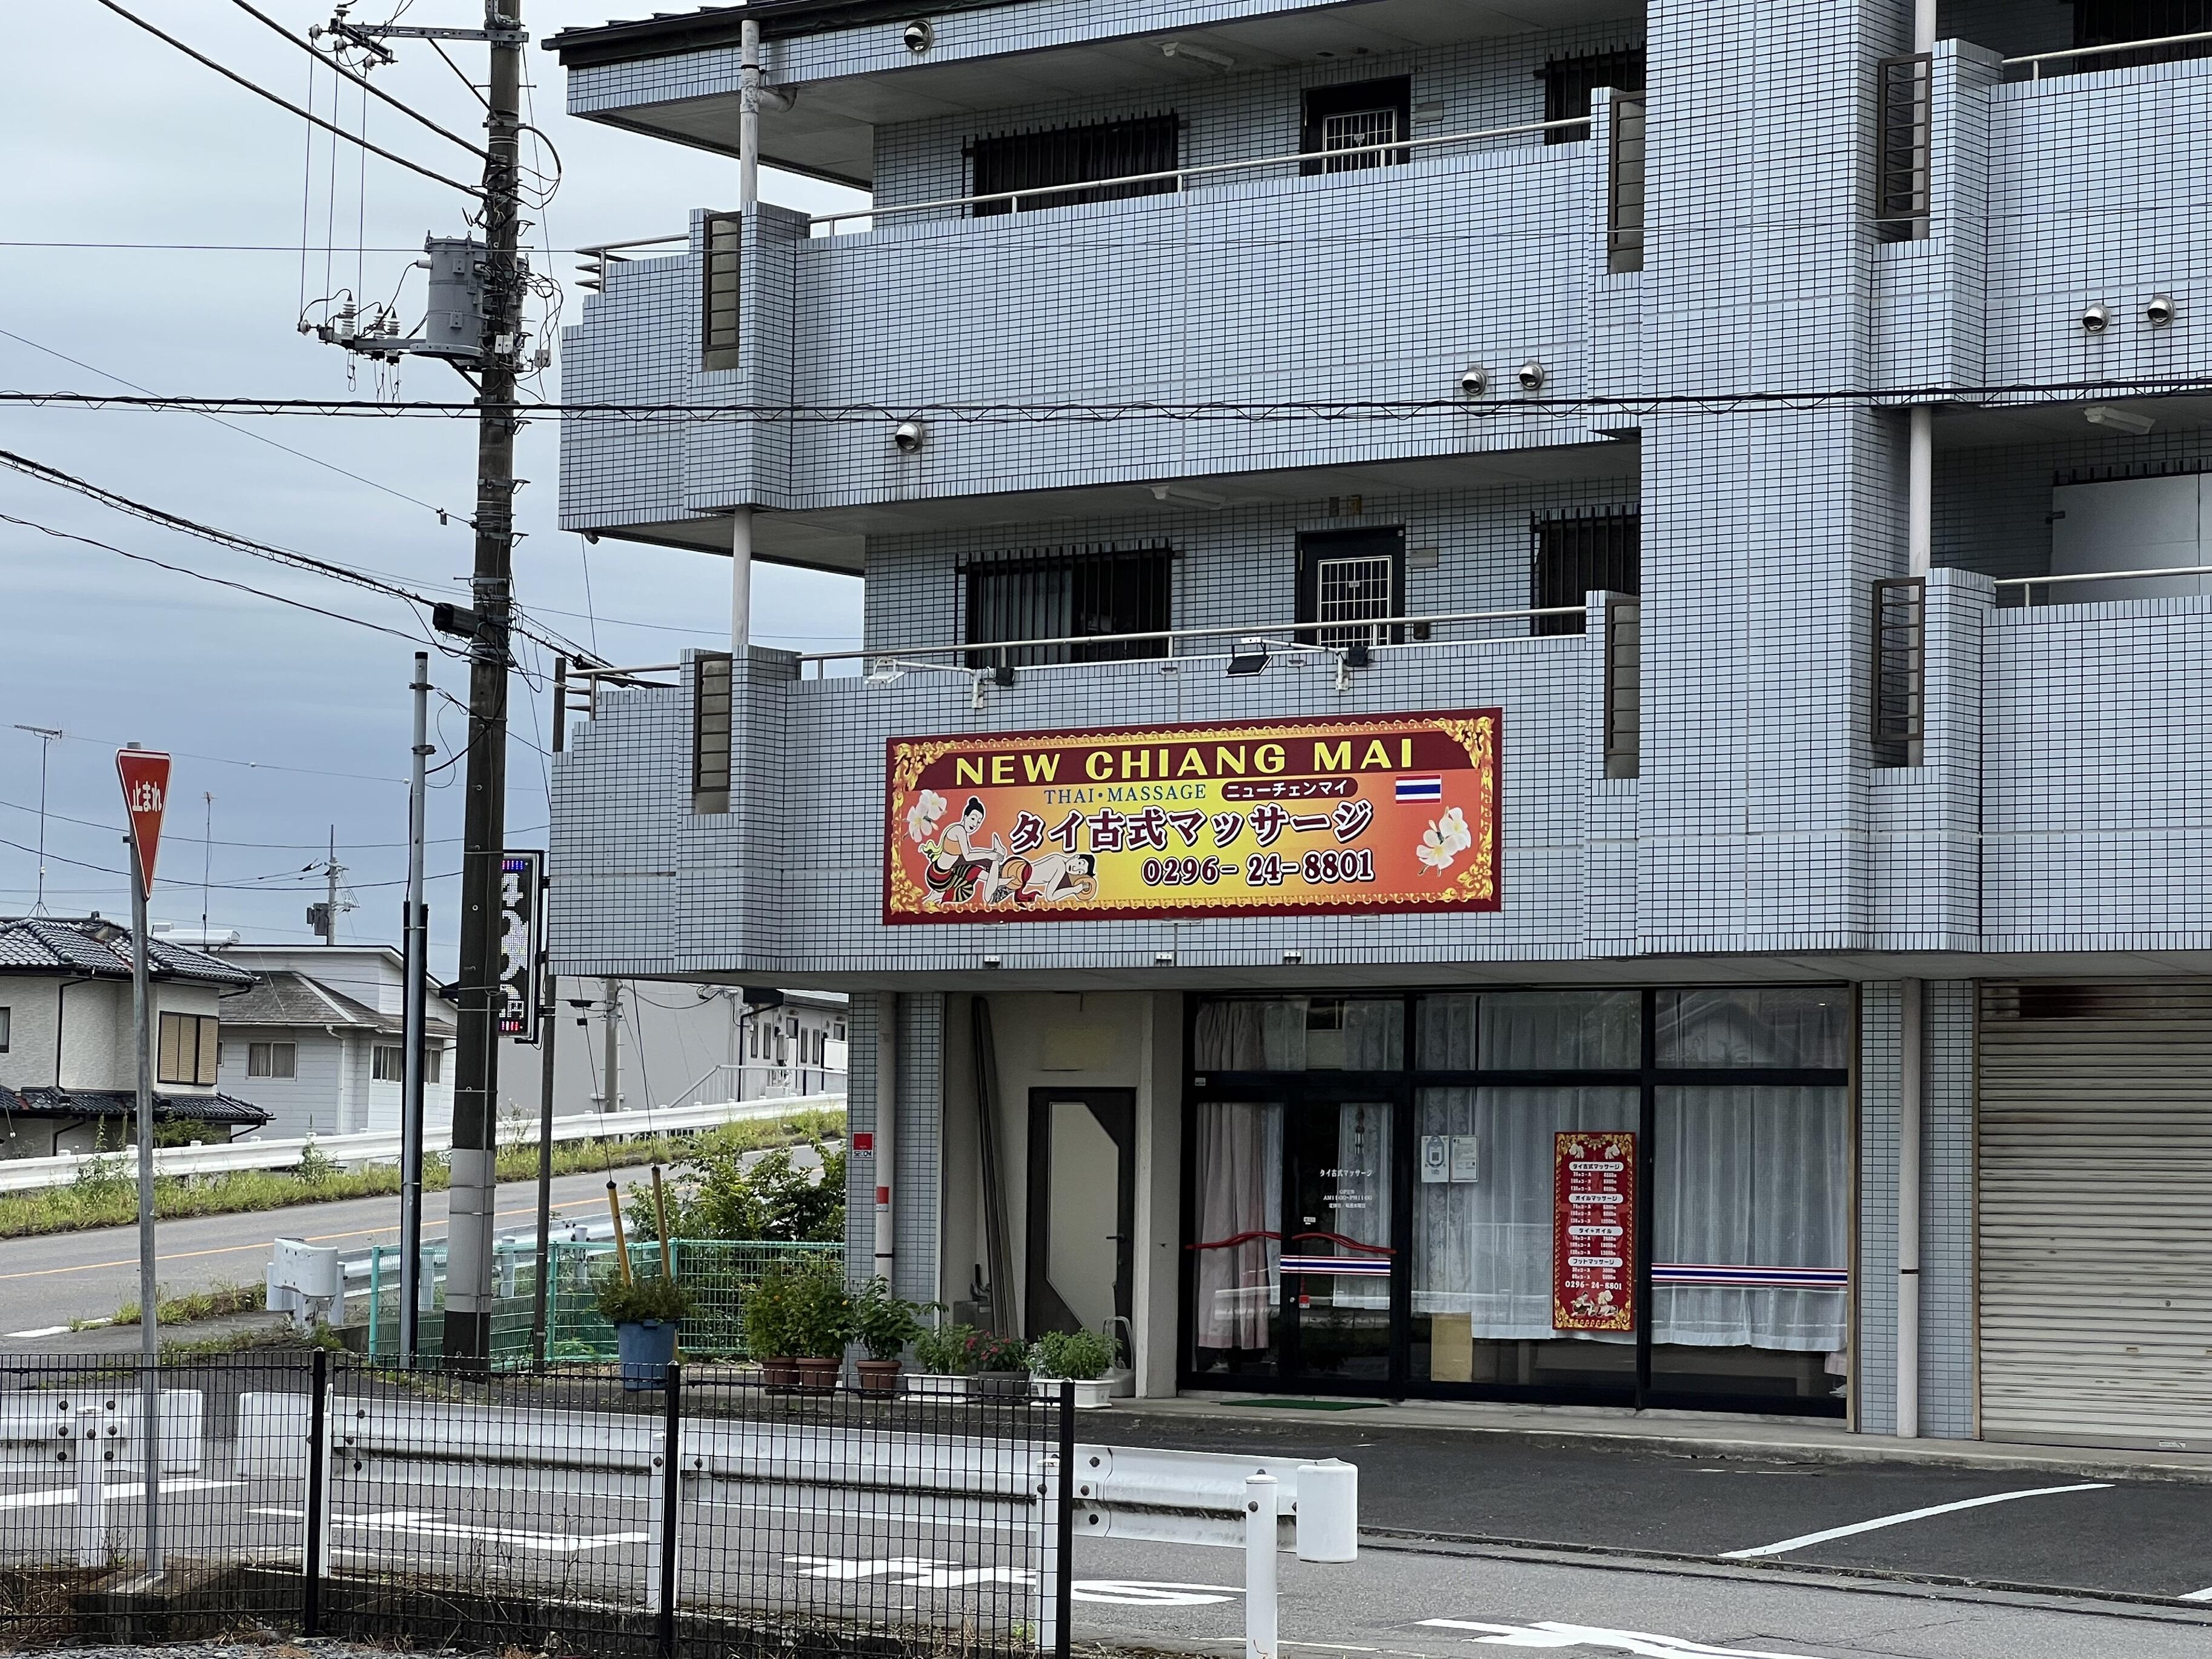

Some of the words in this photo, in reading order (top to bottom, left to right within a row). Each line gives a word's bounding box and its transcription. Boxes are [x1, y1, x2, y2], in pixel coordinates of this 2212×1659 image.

[956, 754, 1060, 785] NEW
[1085, 743, 1286, 780] CHIANG
[1314, 738, 1412, 771] MAI
[132, 780, 162, 812] 止まれ
[1226, 779, 1347, 798] ニューチェンマイ
[1010, 802, 1373, 853] タイ古式マッサージ
